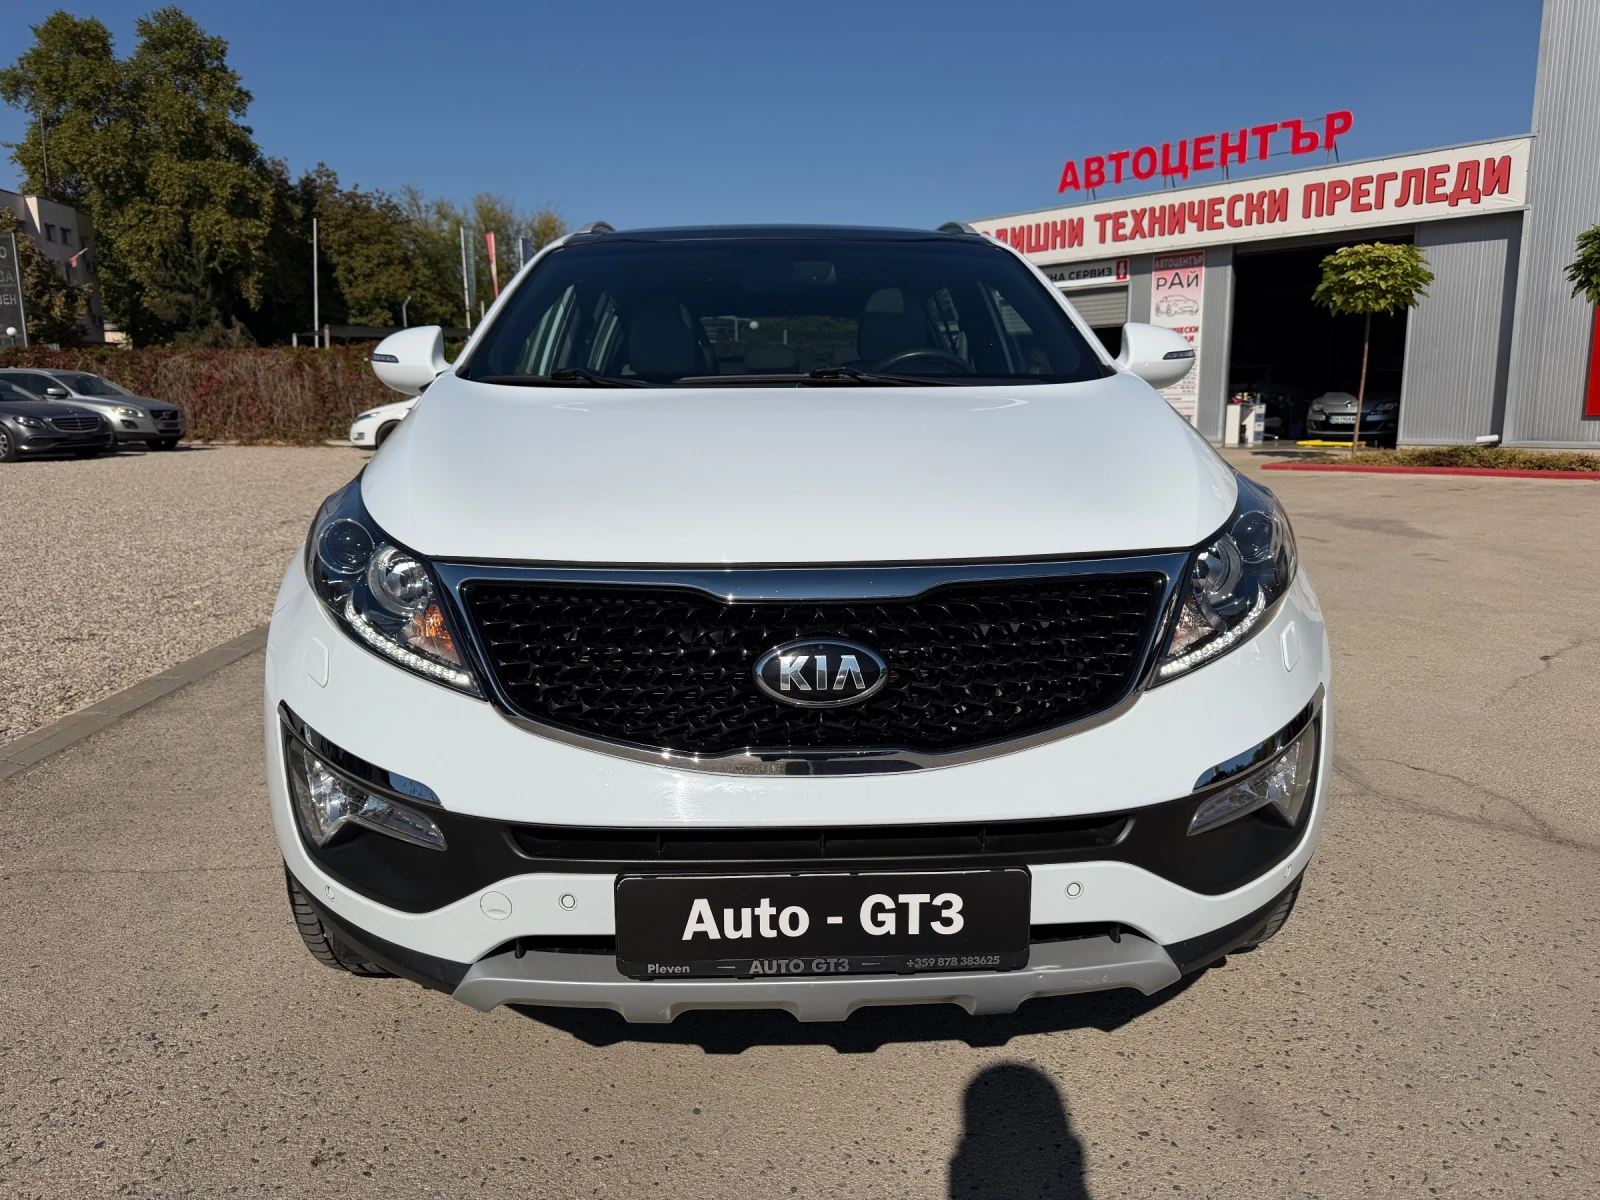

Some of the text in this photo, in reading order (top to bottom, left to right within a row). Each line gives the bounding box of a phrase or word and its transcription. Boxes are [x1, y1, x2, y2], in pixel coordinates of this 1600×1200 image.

[1058, 110, 1354, 194] АВТОЦЕНТЪР
[1094, 187, 1289, 245] ТЕХНИЧЕСКИ
[1302, 155, 1512, 220] ПРЕГЛЕДИ
[1068, 266, 1112, 280] СЕРВИЗ
[1154, 254, 1203, 269] АВТОЦЕНТЪР
[1156, 269, 1199, 291] РАЙ
[778, 654, 866, 691] KIA
[681, 897, 810, 941] Auto
[859, 892, 966, 937] GT3
[647, 954, 1001, 975] Pleven AUTO GT3 +359 878 383625
